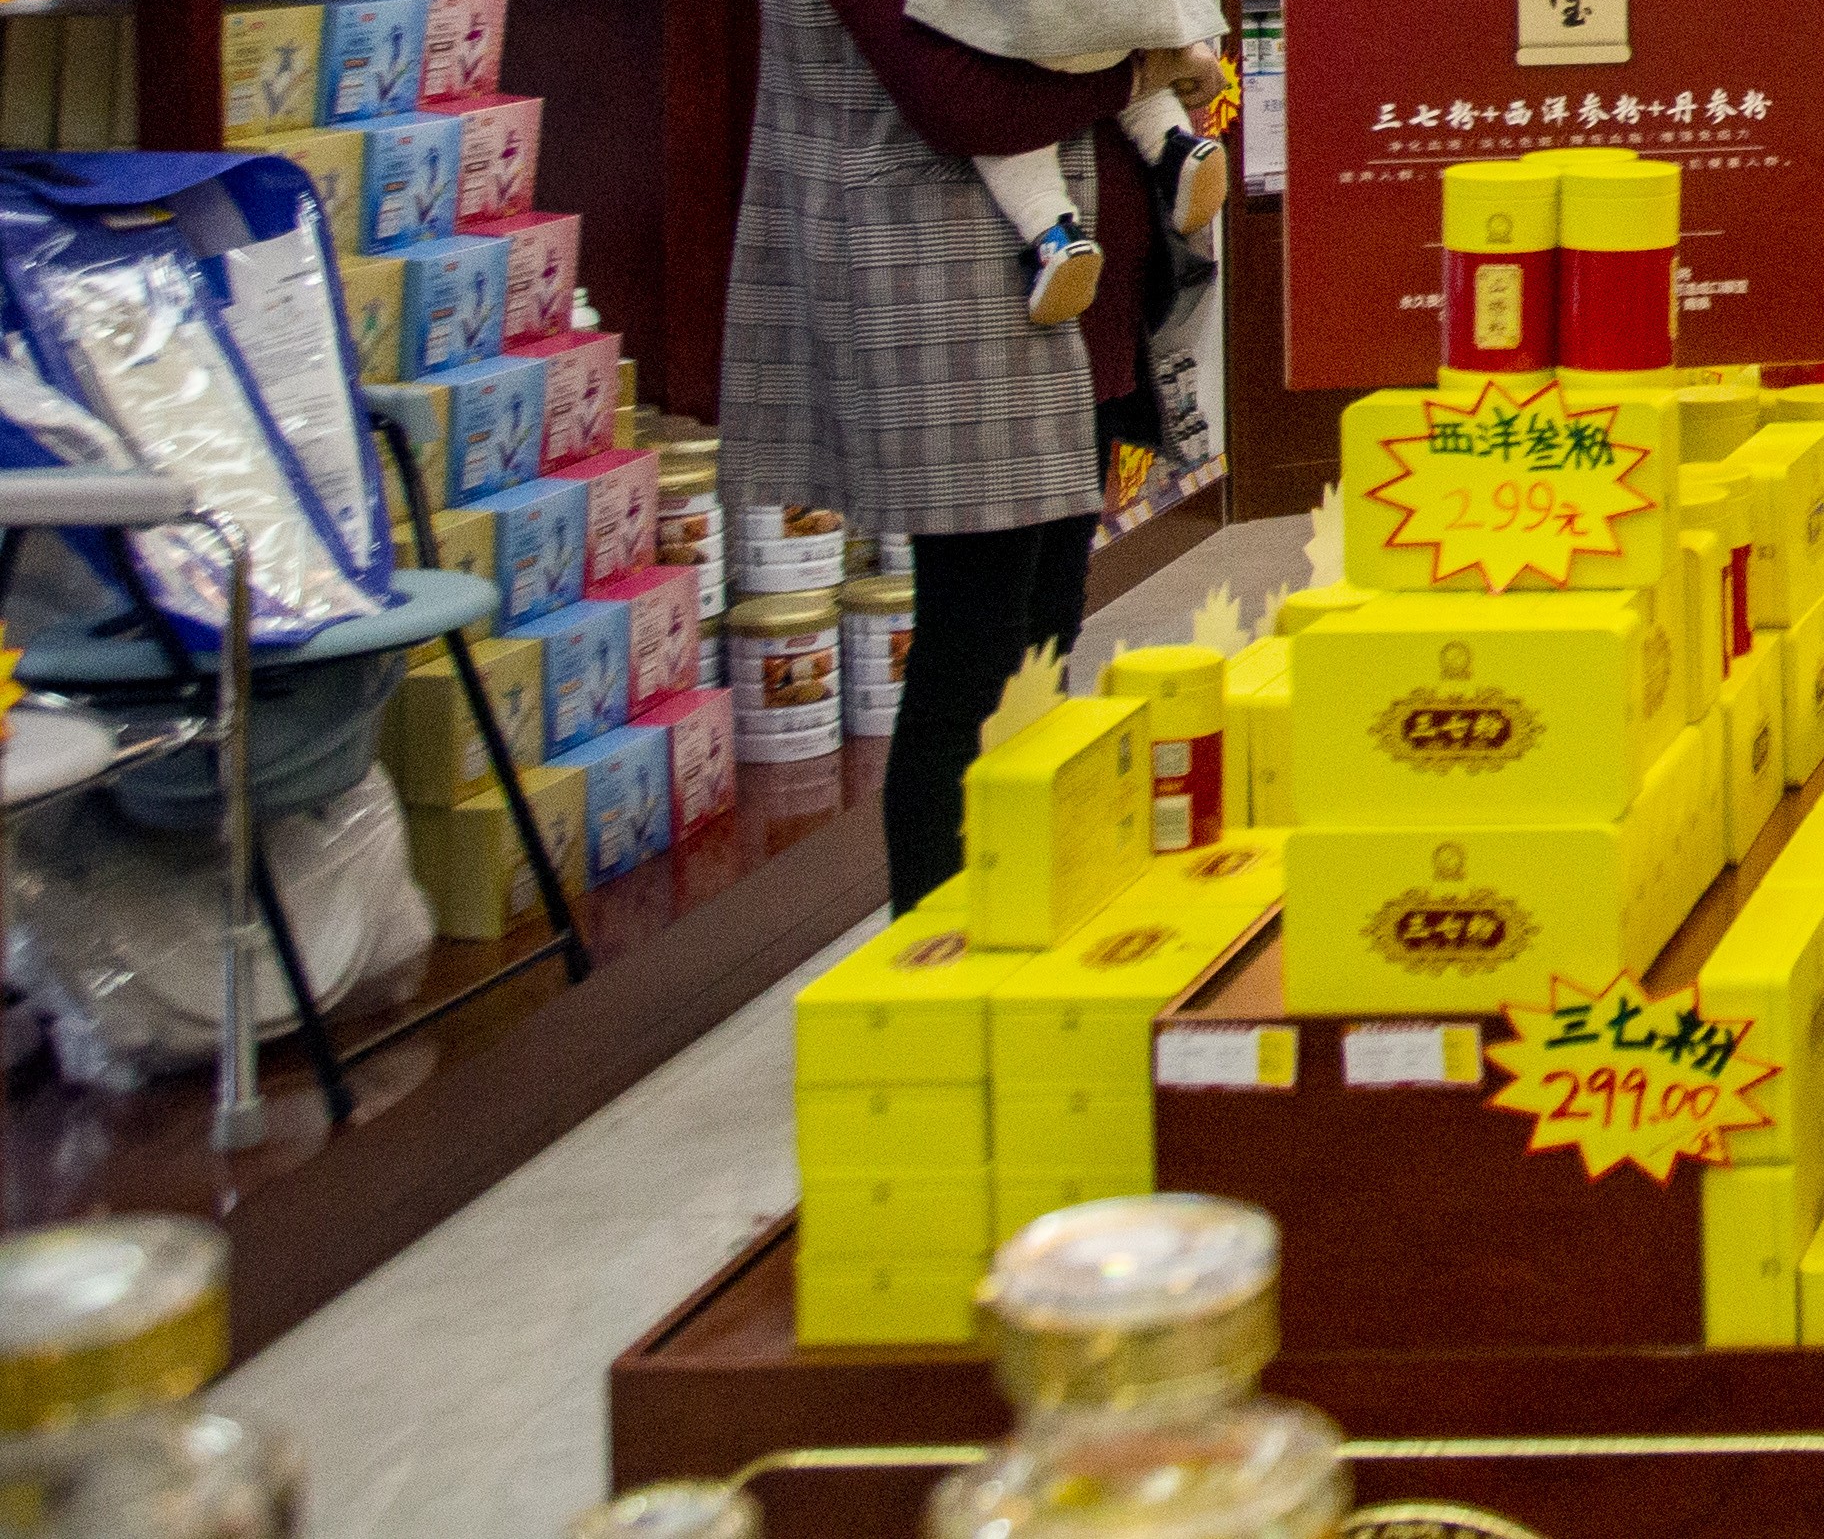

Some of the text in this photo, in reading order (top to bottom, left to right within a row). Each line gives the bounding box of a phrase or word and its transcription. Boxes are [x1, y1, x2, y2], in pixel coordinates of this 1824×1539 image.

[1371, 86, 1773, 132] 三七粉+西洋参粉+丹参粉
[1444, 479, 1588, 538] 299元
[1408, 710, 1509, 743] 三七粉
[1403, 911, 1505, 945] 三七粉
[1547, 980, 1738, 1078] 三七粉
